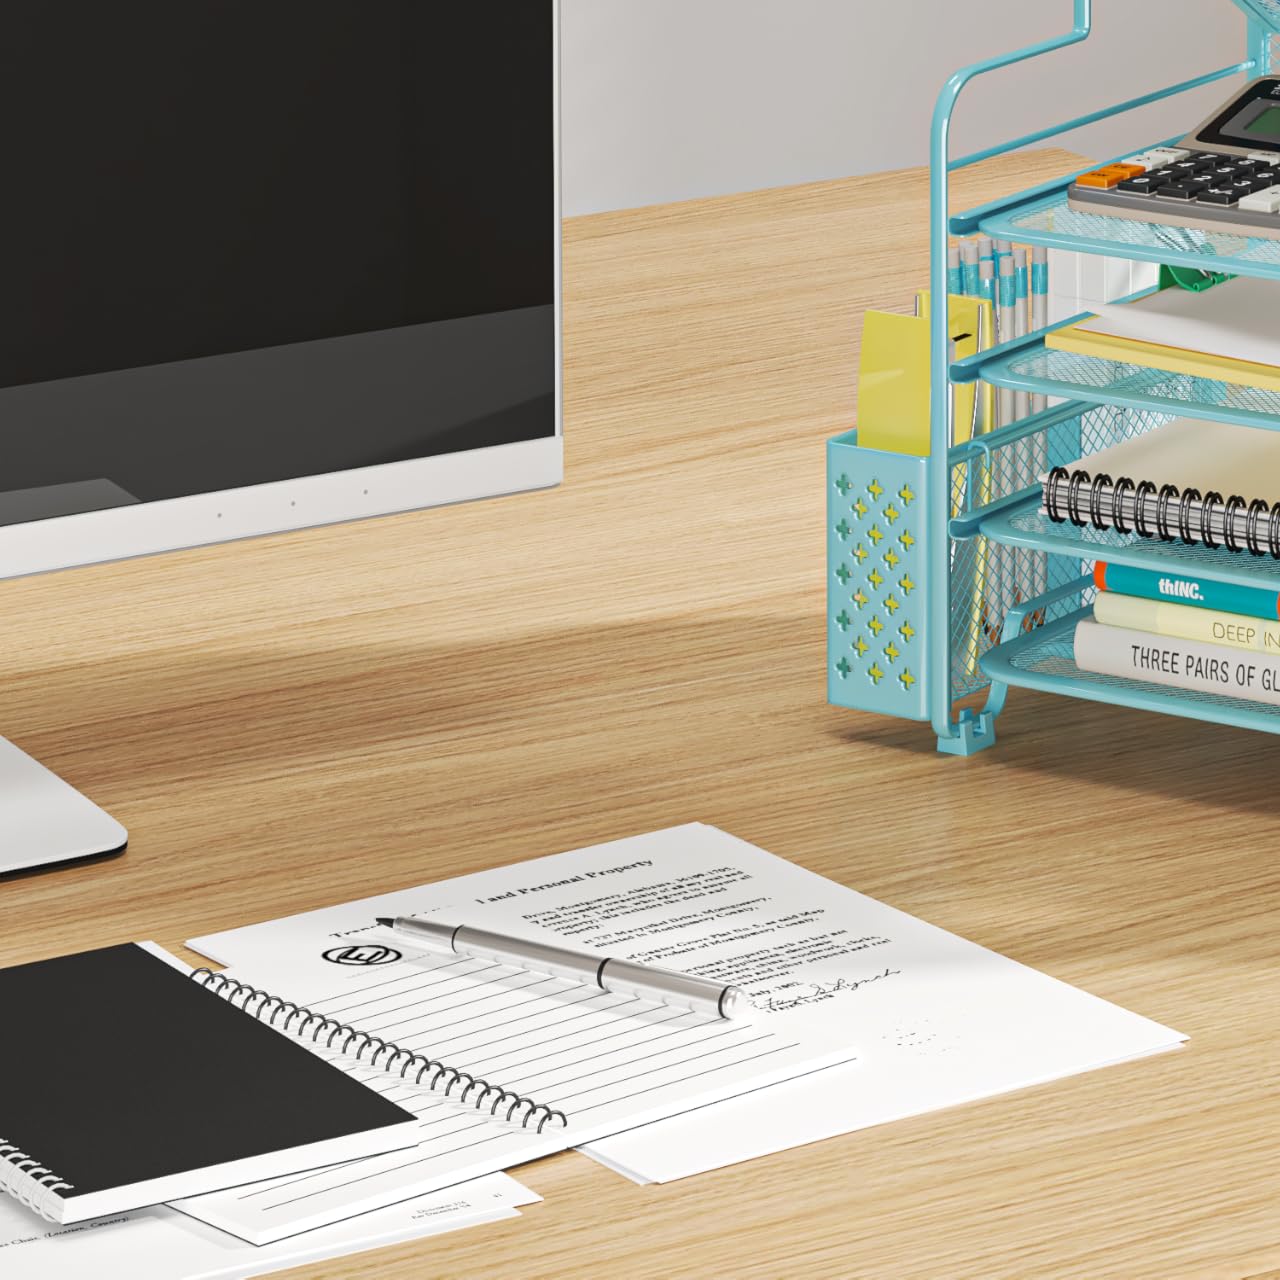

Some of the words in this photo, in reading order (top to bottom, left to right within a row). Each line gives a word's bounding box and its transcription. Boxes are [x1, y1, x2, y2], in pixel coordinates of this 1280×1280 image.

[1212, 622, 1255, 644] DEEP
[1131, 645, 1180, 674] THREE
[1186, 655, 1229, 683] PAIRS
[1236, 664, 1256, 687] OF
[487, 892, 517, 902] and
[517, 876, 586, 894] Personal
[584, 860, 653, 878] Property
